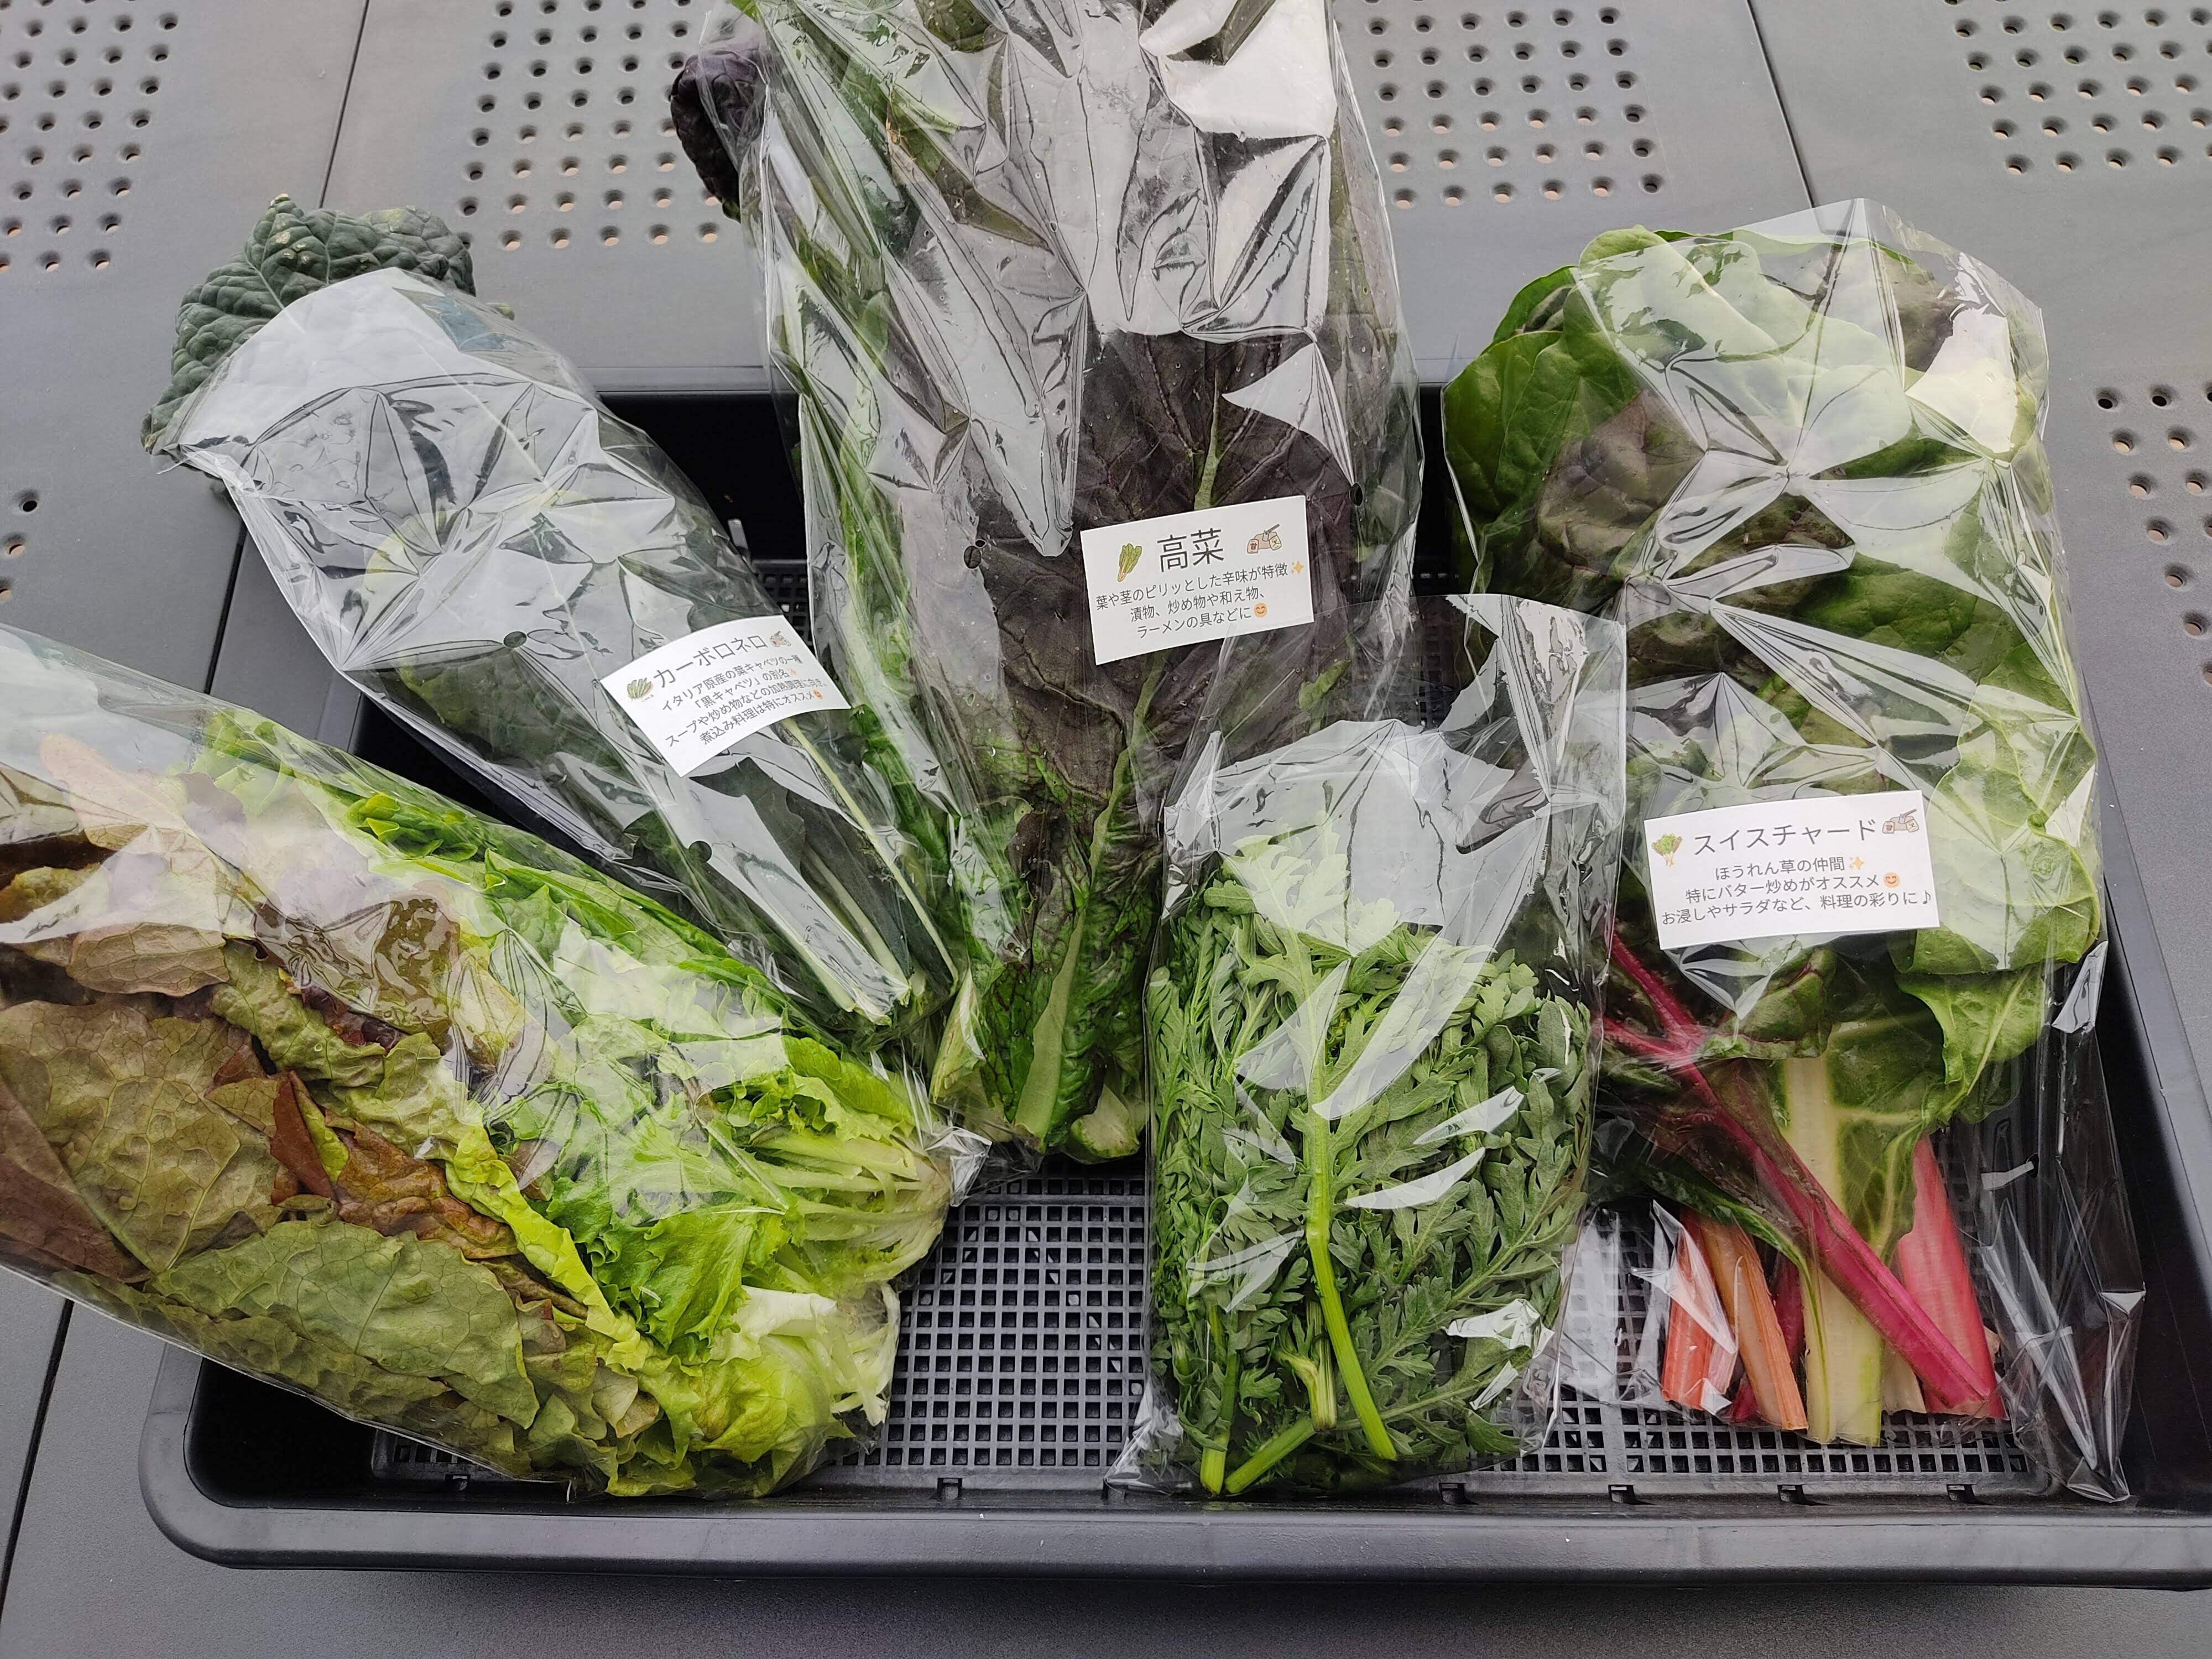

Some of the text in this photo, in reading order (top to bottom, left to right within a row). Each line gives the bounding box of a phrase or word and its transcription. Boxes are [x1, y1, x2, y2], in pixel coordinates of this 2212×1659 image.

[1157, 528, 1224, 572] 高菜
[1096, 562, 1288, 610] 葉や茎のピリッとした辛味が特徴
[1130, 587, 1265, 622] 漬物、炒め物や和え物、
[1137, 606, 1251, 639] ラーメンの具などに
[653, 635, 768, 688] カーボロネロ
[695, 669, 790, 708] 「黒キャベツ」の別名
[700, 691, 813, 745] 煮込み料理は特にオススメ
[1694, 819, 1876, 855] スイスチャード
[1715, 857, 1845, 880] ほうれん草の仲間
[1686, 873, 1880, 904] 特にバター炒めがオススメ
